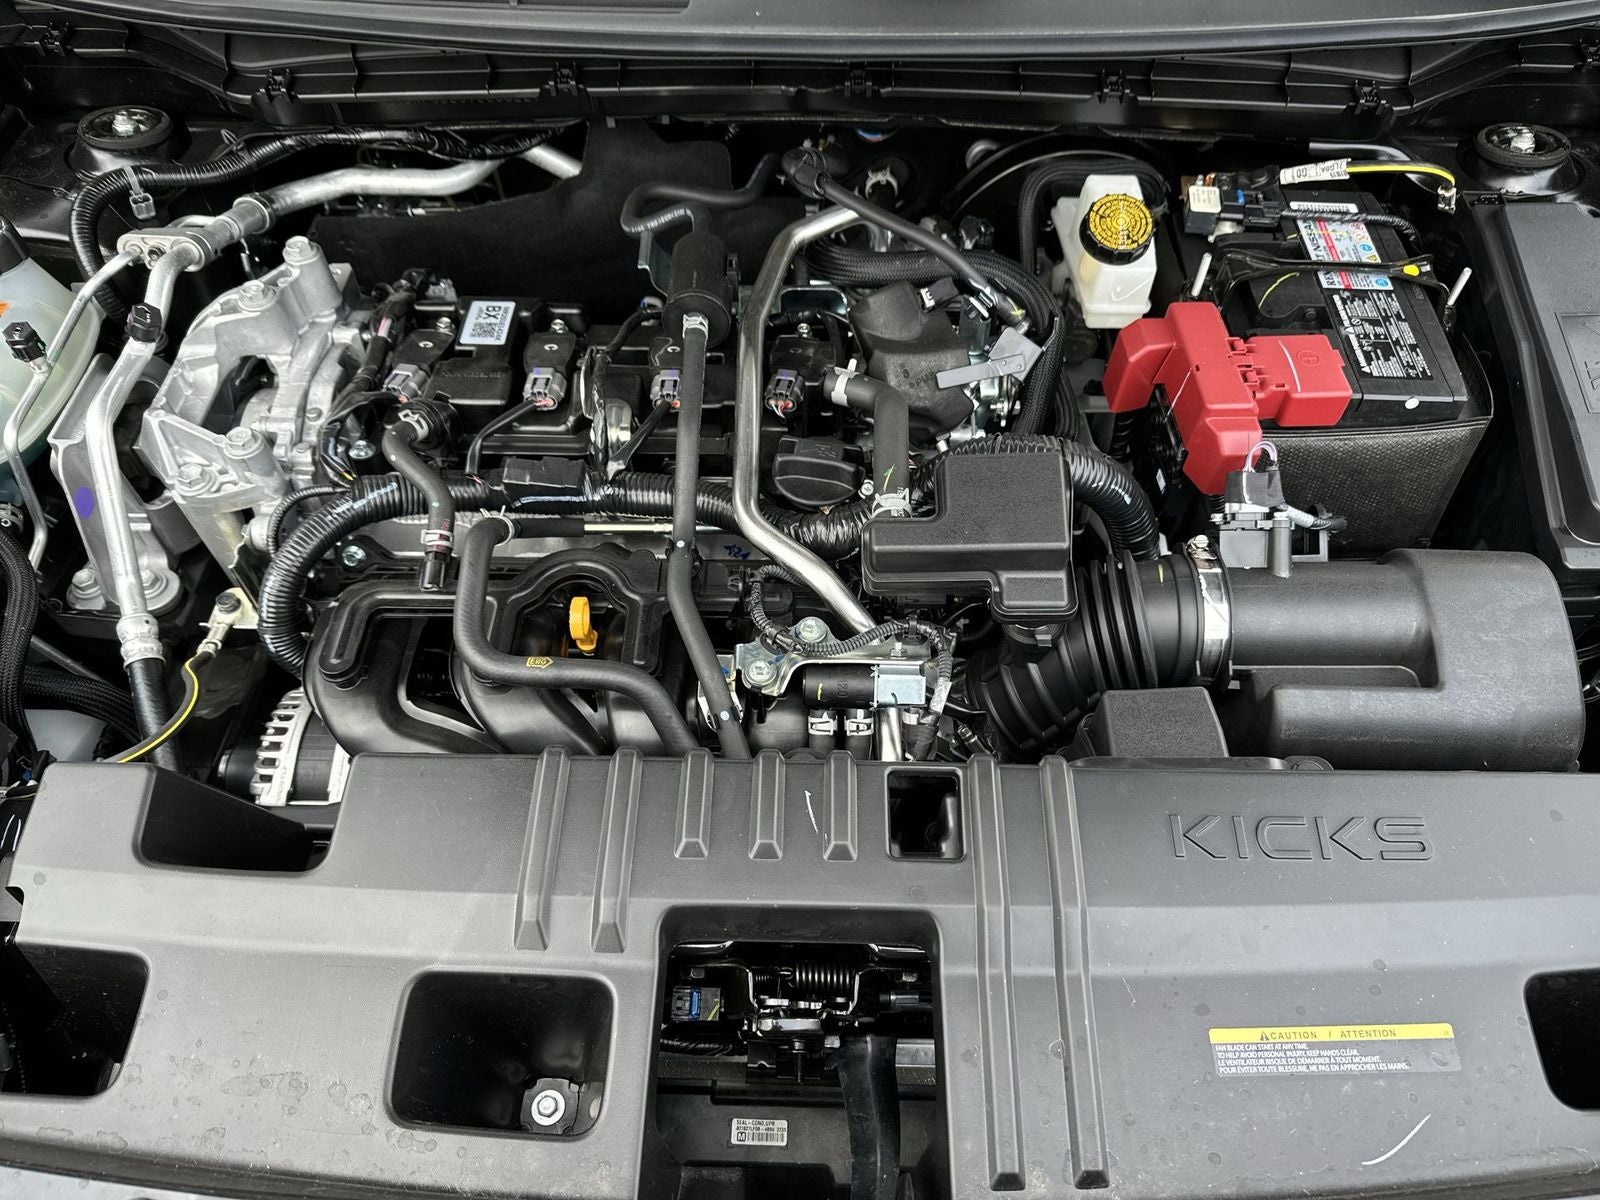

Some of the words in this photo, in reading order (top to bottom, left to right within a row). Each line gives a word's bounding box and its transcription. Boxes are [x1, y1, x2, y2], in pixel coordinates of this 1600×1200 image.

[482, 306, 501, 319] BX
[1168, 814, 1434, 861] KICKS
[1270, 1031, 1317, 1040] CAUTION
[1340, 1029, 1397, 1039] ATTENTION
[1258, 1050, 1285, 1058] PERSONAL
[1225, 1058, 1265, 1066] VENTILATEUR
[1340, 1063, 1376, 1071] APPROCHER
